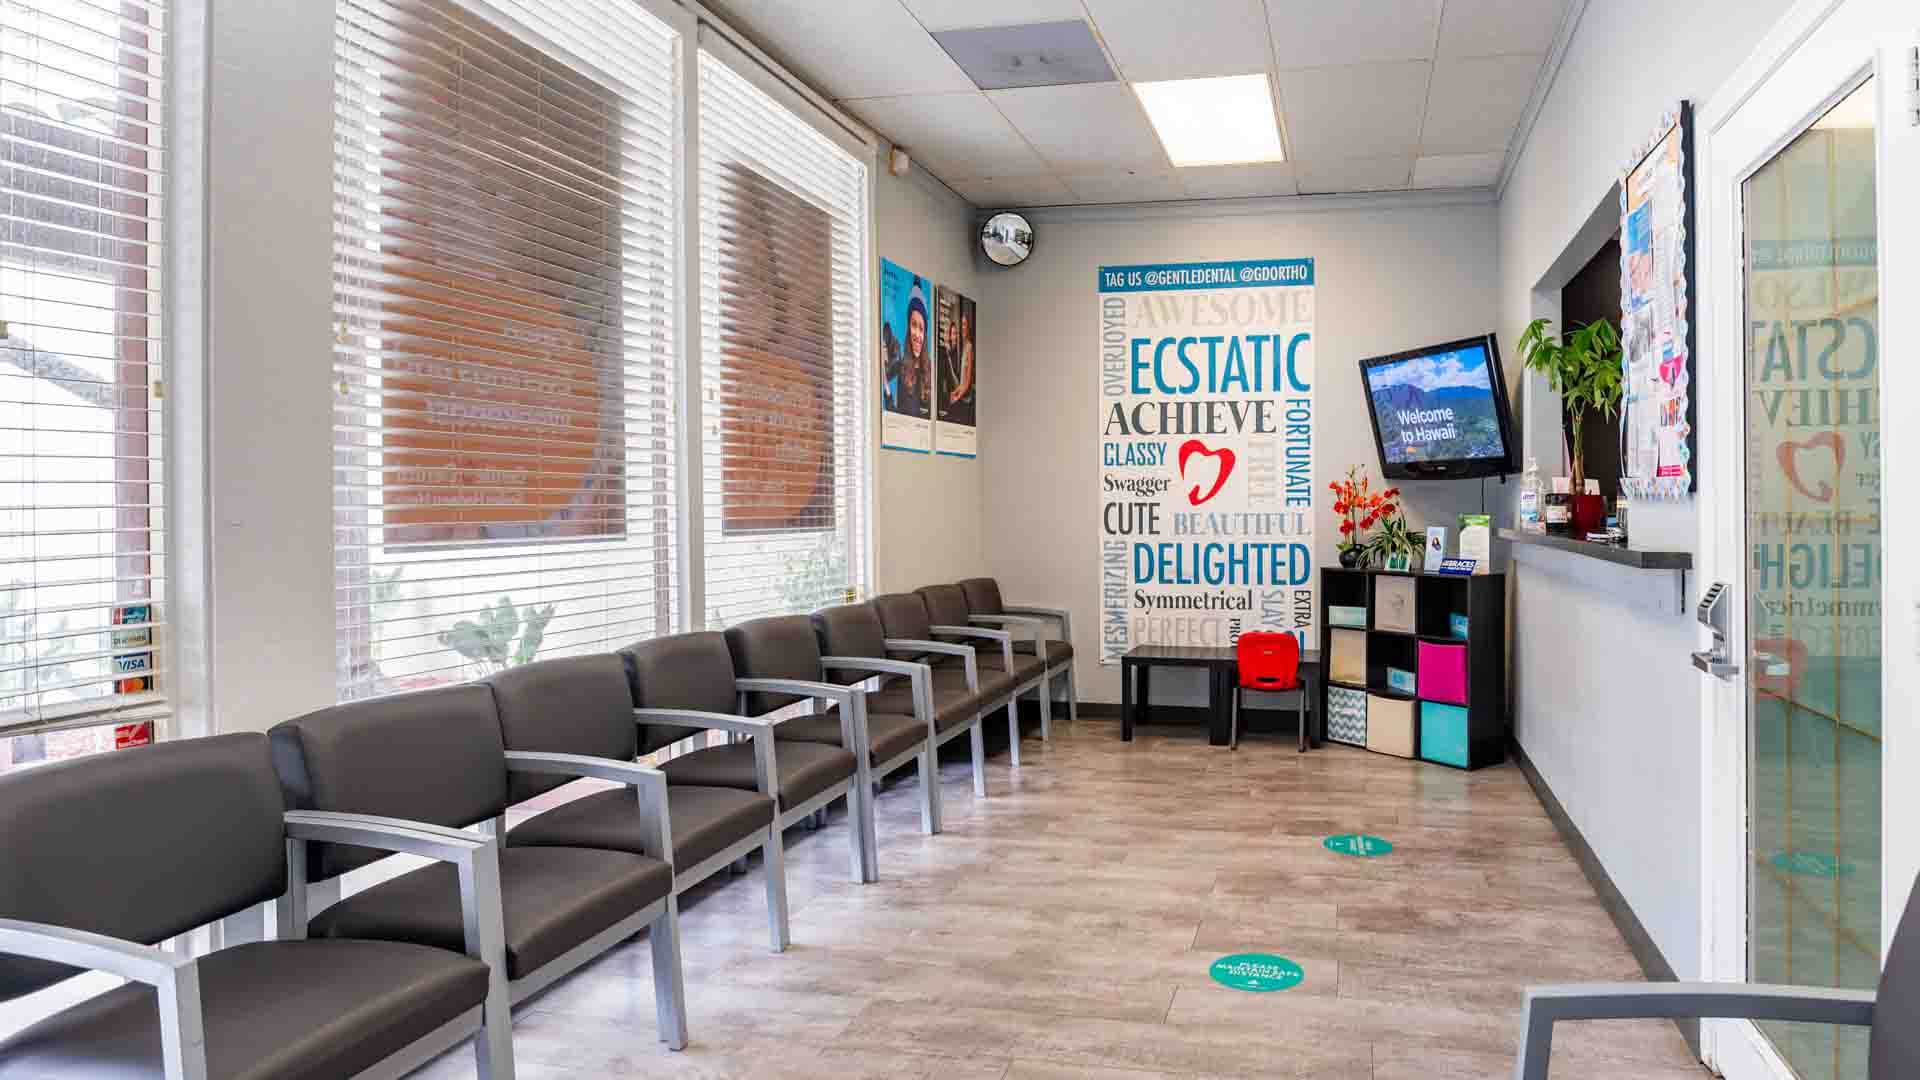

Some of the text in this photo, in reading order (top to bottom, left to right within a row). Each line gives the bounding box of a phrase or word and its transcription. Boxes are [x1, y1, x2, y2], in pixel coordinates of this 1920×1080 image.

[1105, 265, 1307, 287] TAG US @GENTLEDENTAL @GDORTHO
[1132, 290, 1312, 328] AWESOME
[1103, 297, 1127, 397] OVERJOYED
[1131, 333, 1311, 394] ECSTATIC
[1104, 400, 1277, 436] ACHIEVE
[1397, 407, 1454, 425] Welcome
[1401, 424, 1456, 442] to Hawaii
[1104, 442, 1168, 467] CLASSY
[1285, 399, 1311, 507] FORTUNATE
[1104, 473, 1170, 497] Swagger
[1104, 502, 1161, 535] CUTE
[1173, 512, 1312, 537] BEAUTIFUL
[1134, 542, 1311, 585] DELIGHTED
[1103, 540, 1128, 661] MESMERIZING
[1134, 589, 1253, 614] Symmetrical
[1262, 590, 1285, 628] SLAY
[1294, 590, 1312, 629] EXTRA
[1135, 616, 1225, 648] PERFECT
[118, 658, 145, 672] VISA
